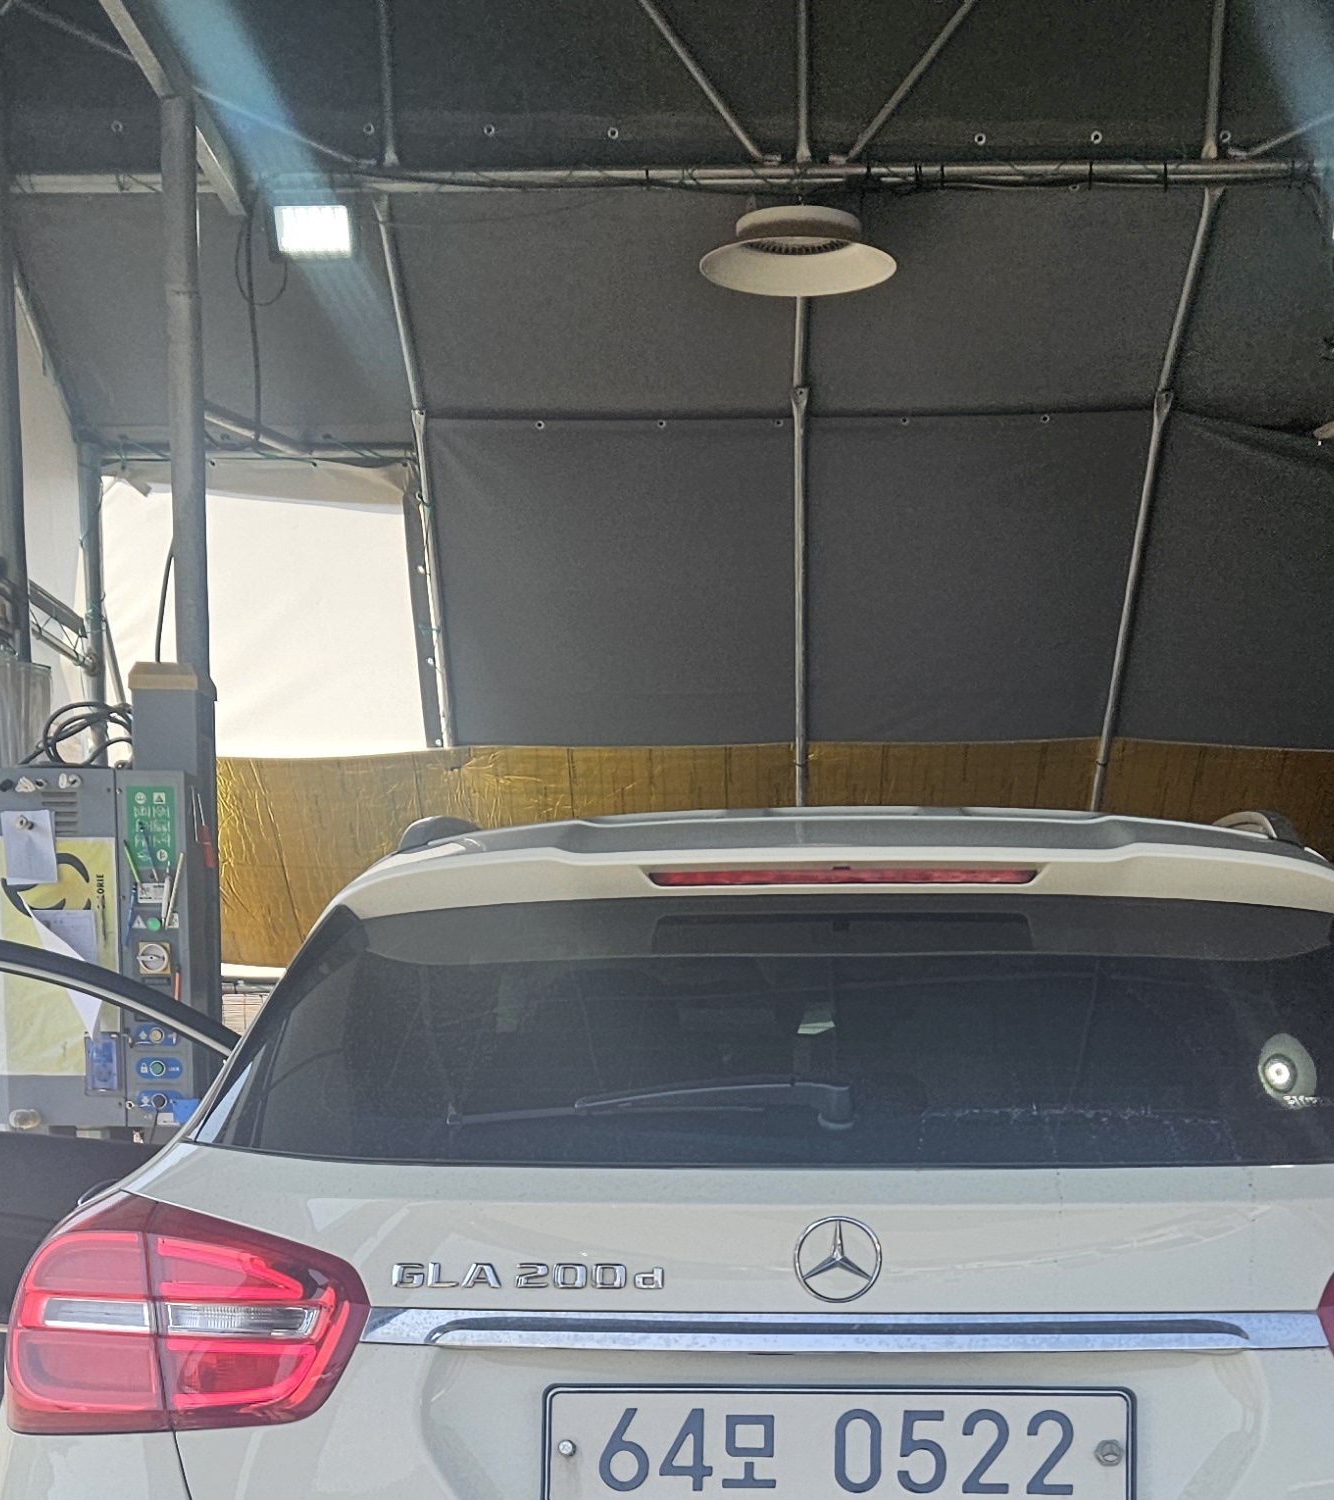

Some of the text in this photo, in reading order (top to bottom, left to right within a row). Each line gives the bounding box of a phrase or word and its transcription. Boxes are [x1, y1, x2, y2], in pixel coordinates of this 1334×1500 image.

[391, 1262, 665, 1290] GLA 200d
[598, 1407, 1075, 1496] 64모 0522
